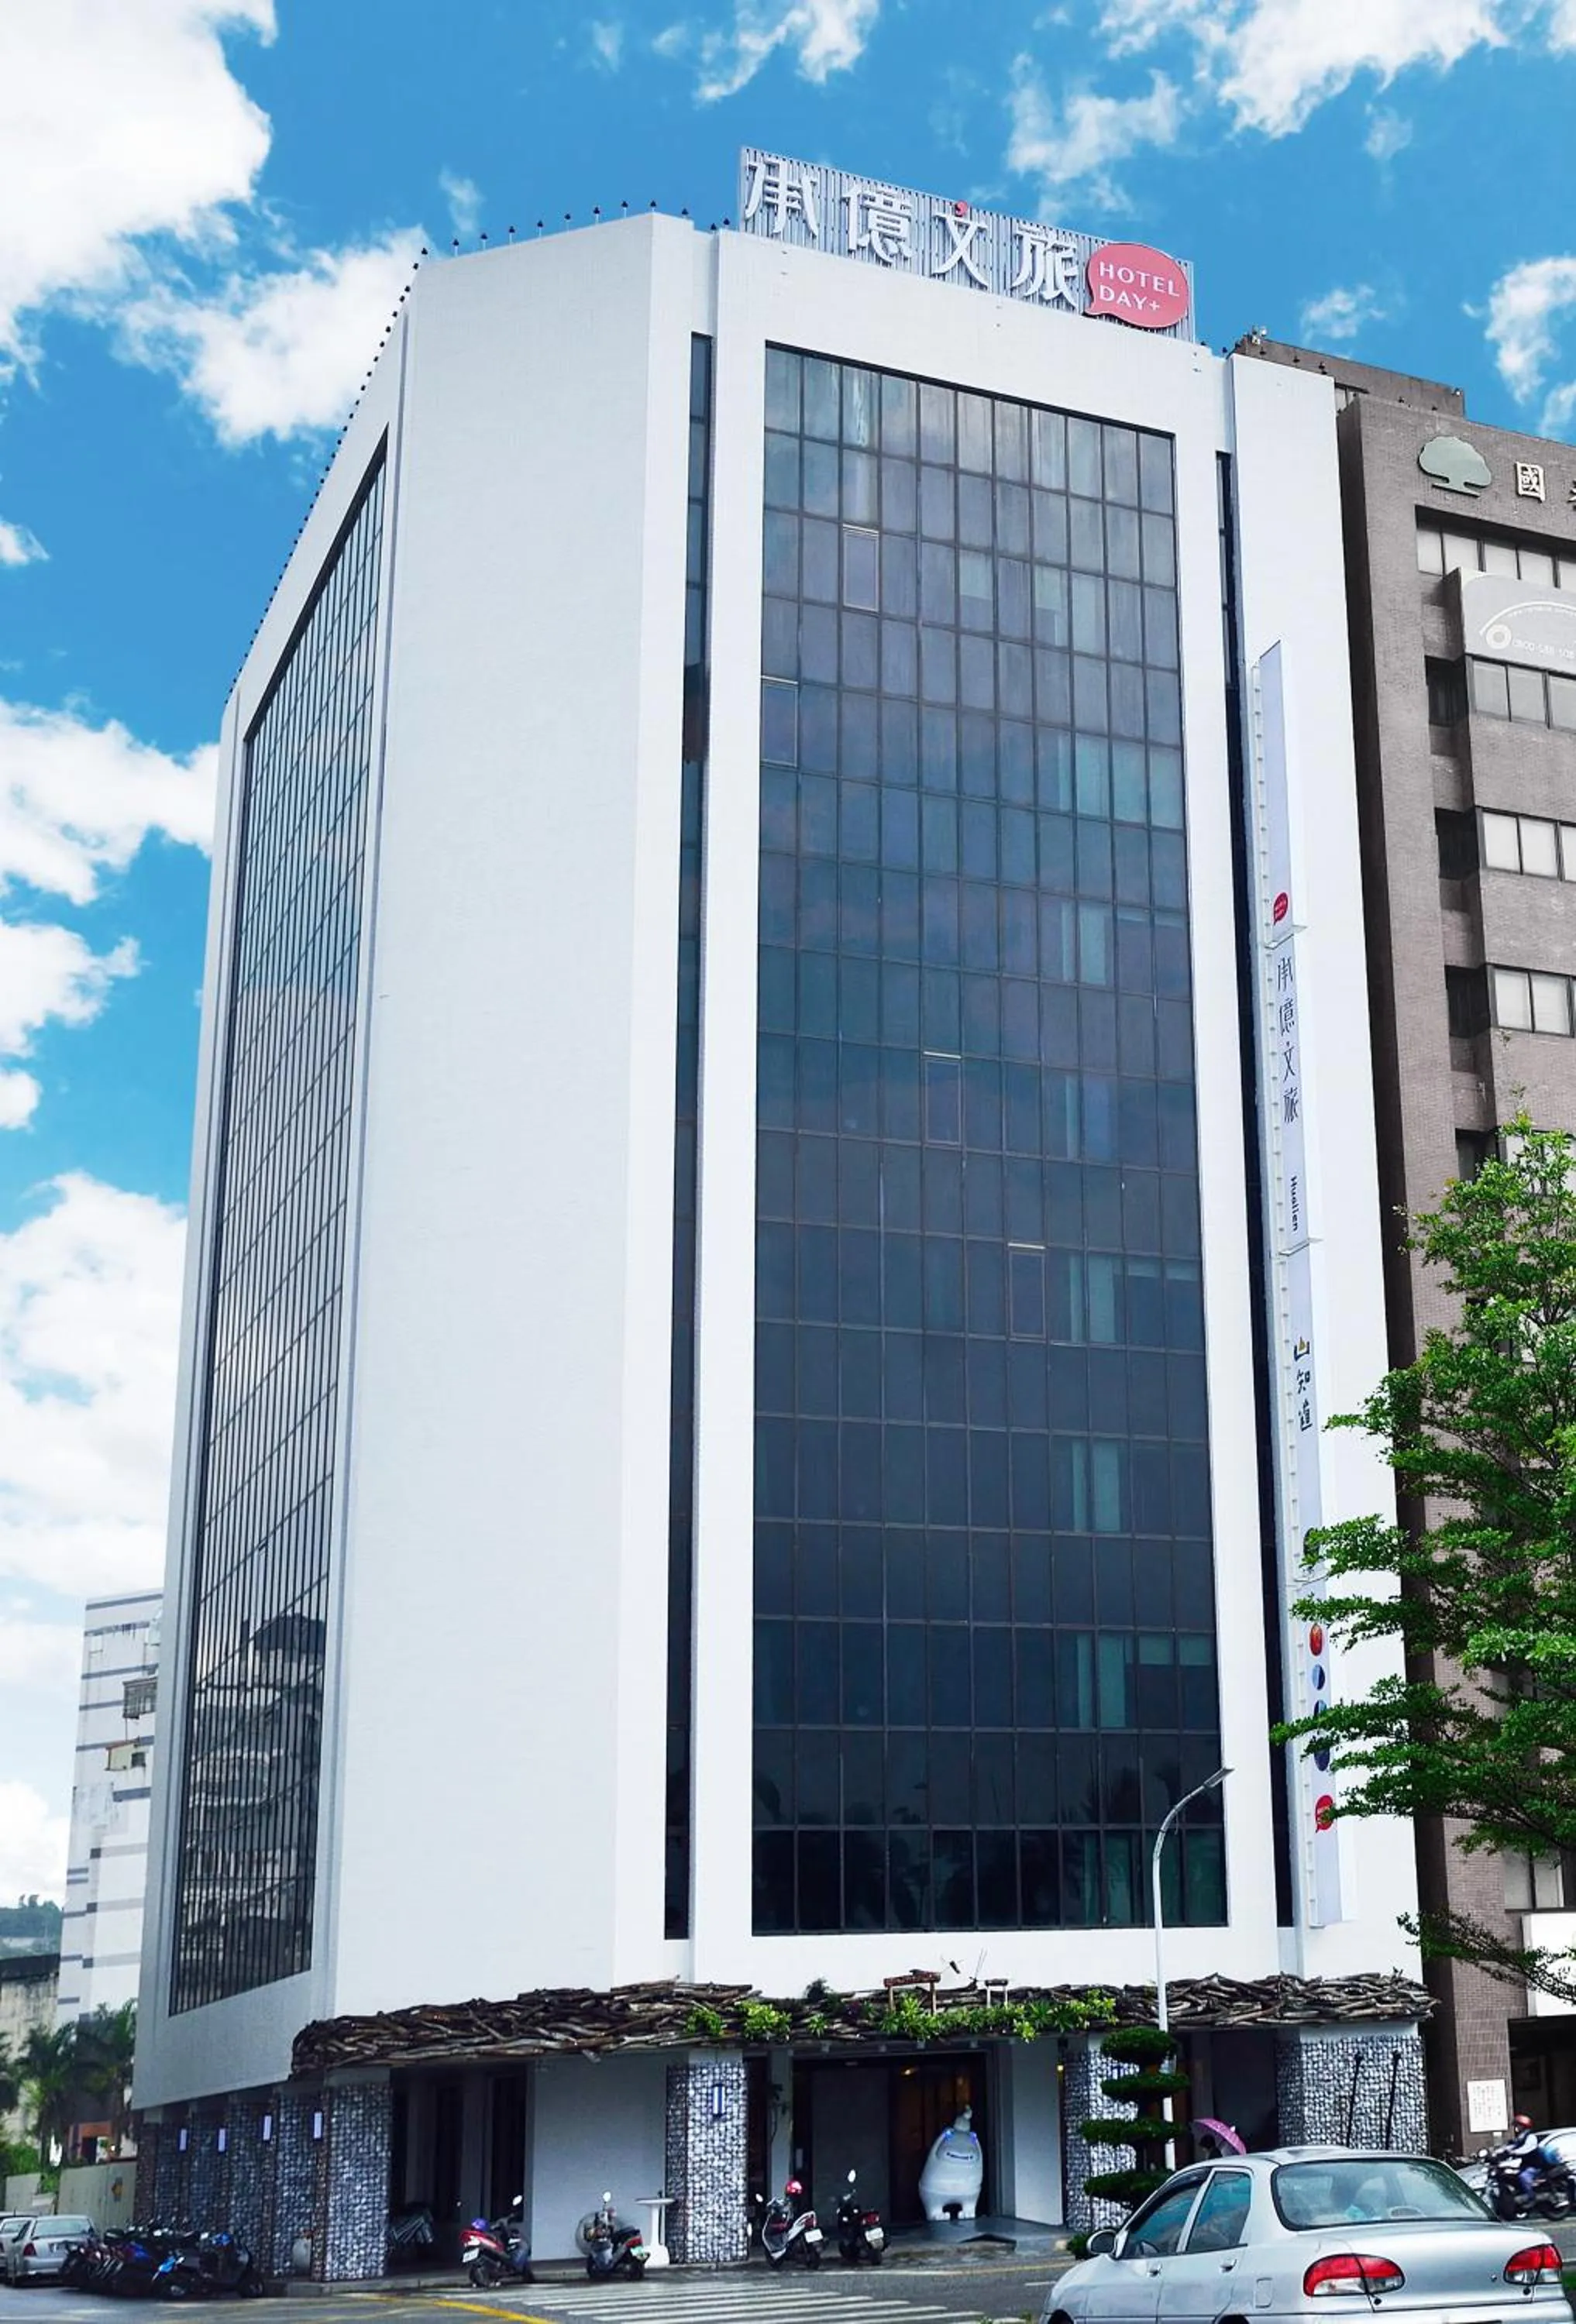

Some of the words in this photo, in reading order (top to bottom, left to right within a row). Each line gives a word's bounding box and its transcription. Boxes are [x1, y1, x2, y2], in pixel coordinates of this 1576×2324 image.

[745, 156, 1080, 310] 承億文旅
[1099, 260, 1180, 297] HOTEL
[1099, 284, 1161, 311] DAY+
[1277, 957, 1299, 1122] 承億文旅
